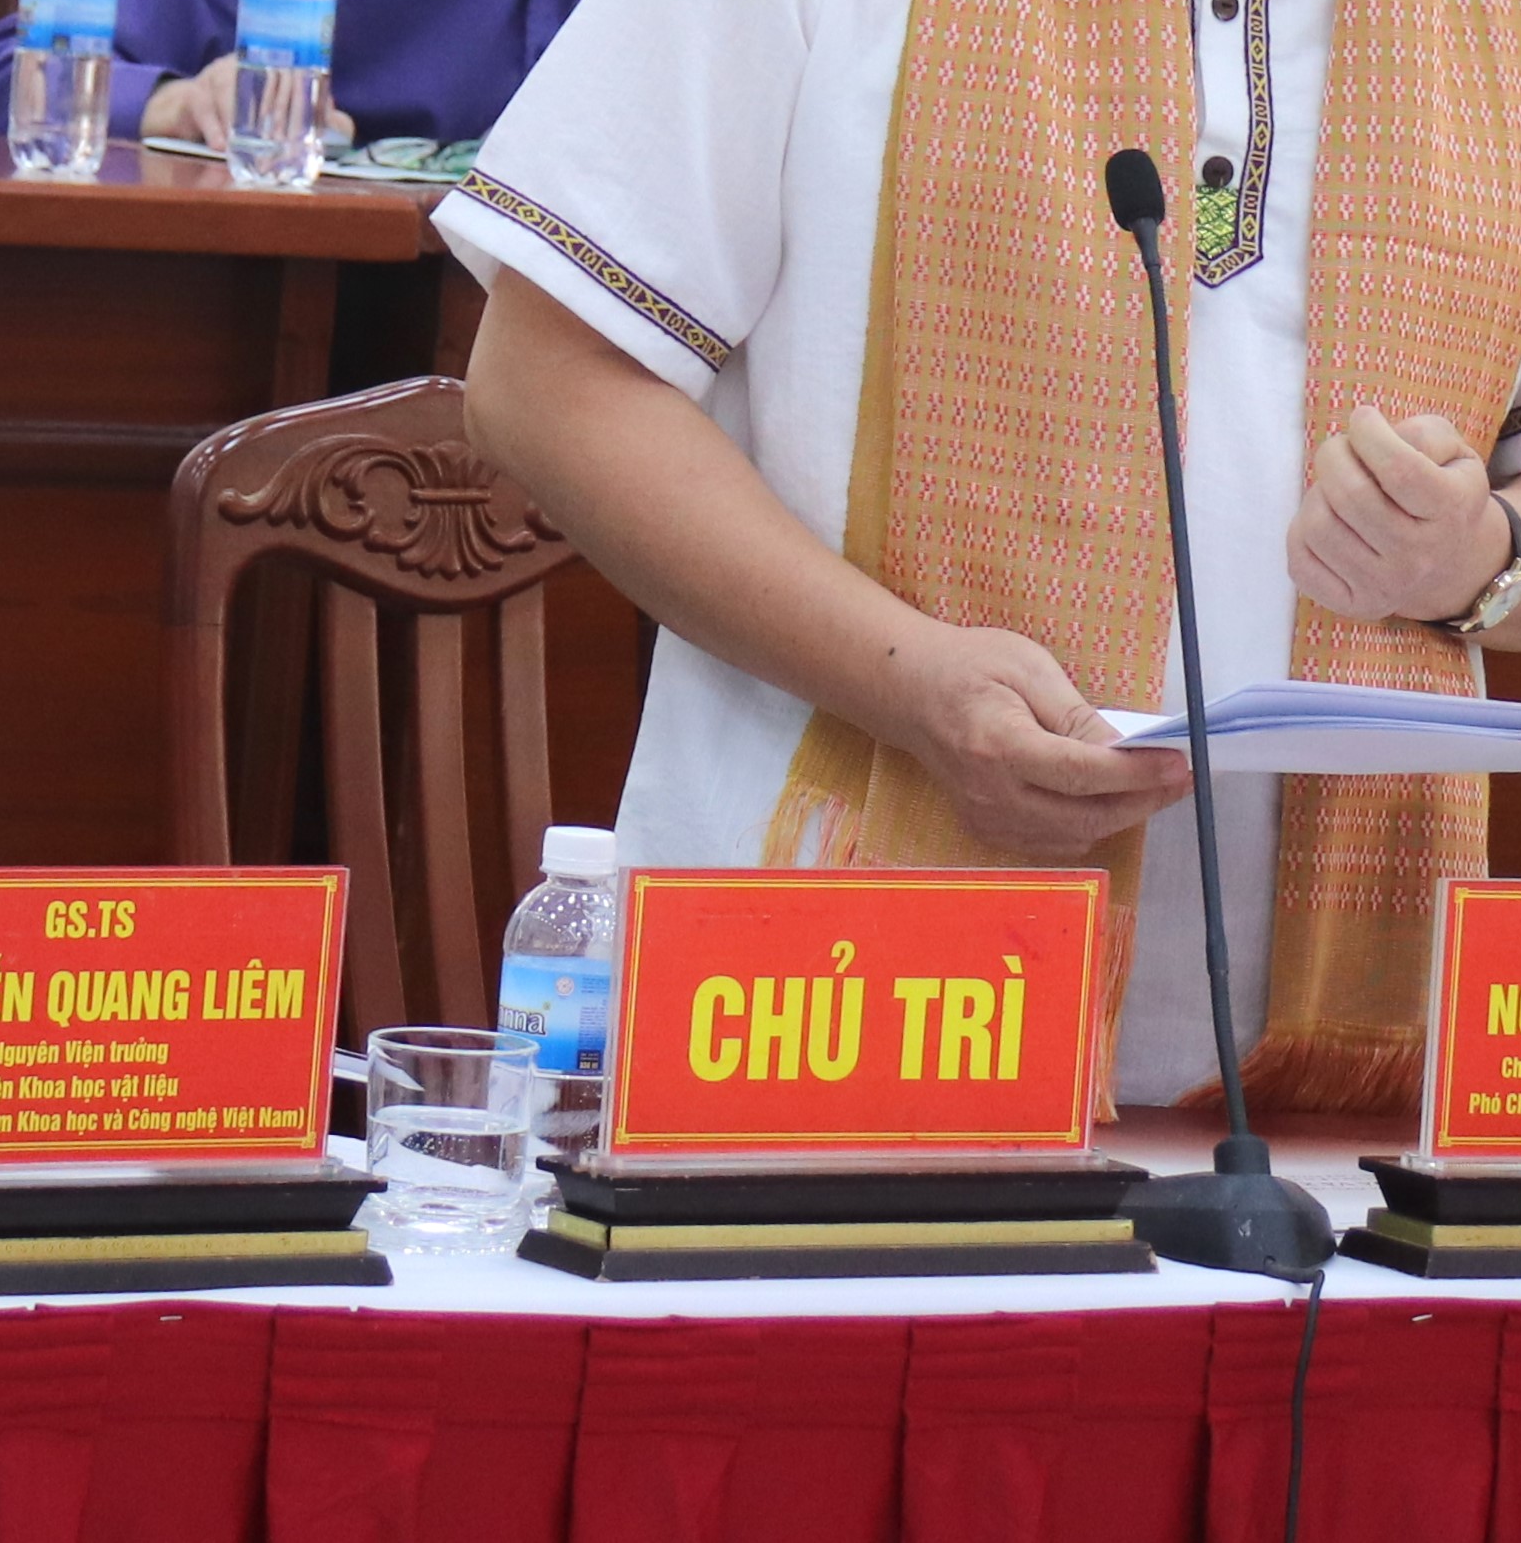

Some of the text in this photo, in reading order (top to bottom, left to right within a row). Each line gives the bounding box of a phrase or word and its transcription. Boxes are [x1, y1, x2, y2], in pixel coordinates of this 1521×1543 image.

[45, 900, 136, 939] GS.TS
[47, 970, 190, 1028] QUANG
[202, 959, 305, 1020] LIÊM
[689, 940, 865, 1082] CHỦ
[893, 955, 1025, 1080] TRÌ
[65, 1041, 105, 1067] Viện
[110, 1040, 169, 1065] trưởng
[18, 1077, 66, 1099] Khoa
[71, 1077, 105, 1102] học
[111, 1075, 139, 1101] vật
[143, 1074, 179, 1100] liệu
[1469, 1093, 1501, 1114] Phó
[17, 1111, 61, 1132] Khoa
[66, 1112, 98, 1135] học
[103, 1111, 123, 1130] và
[128, 1109, 171, 1132] Công
[176, 1108, 217, 1133] nghệ
[223, 1108, 254, 1130] Việt
[259, 1107, 304, 1128] Nam)
